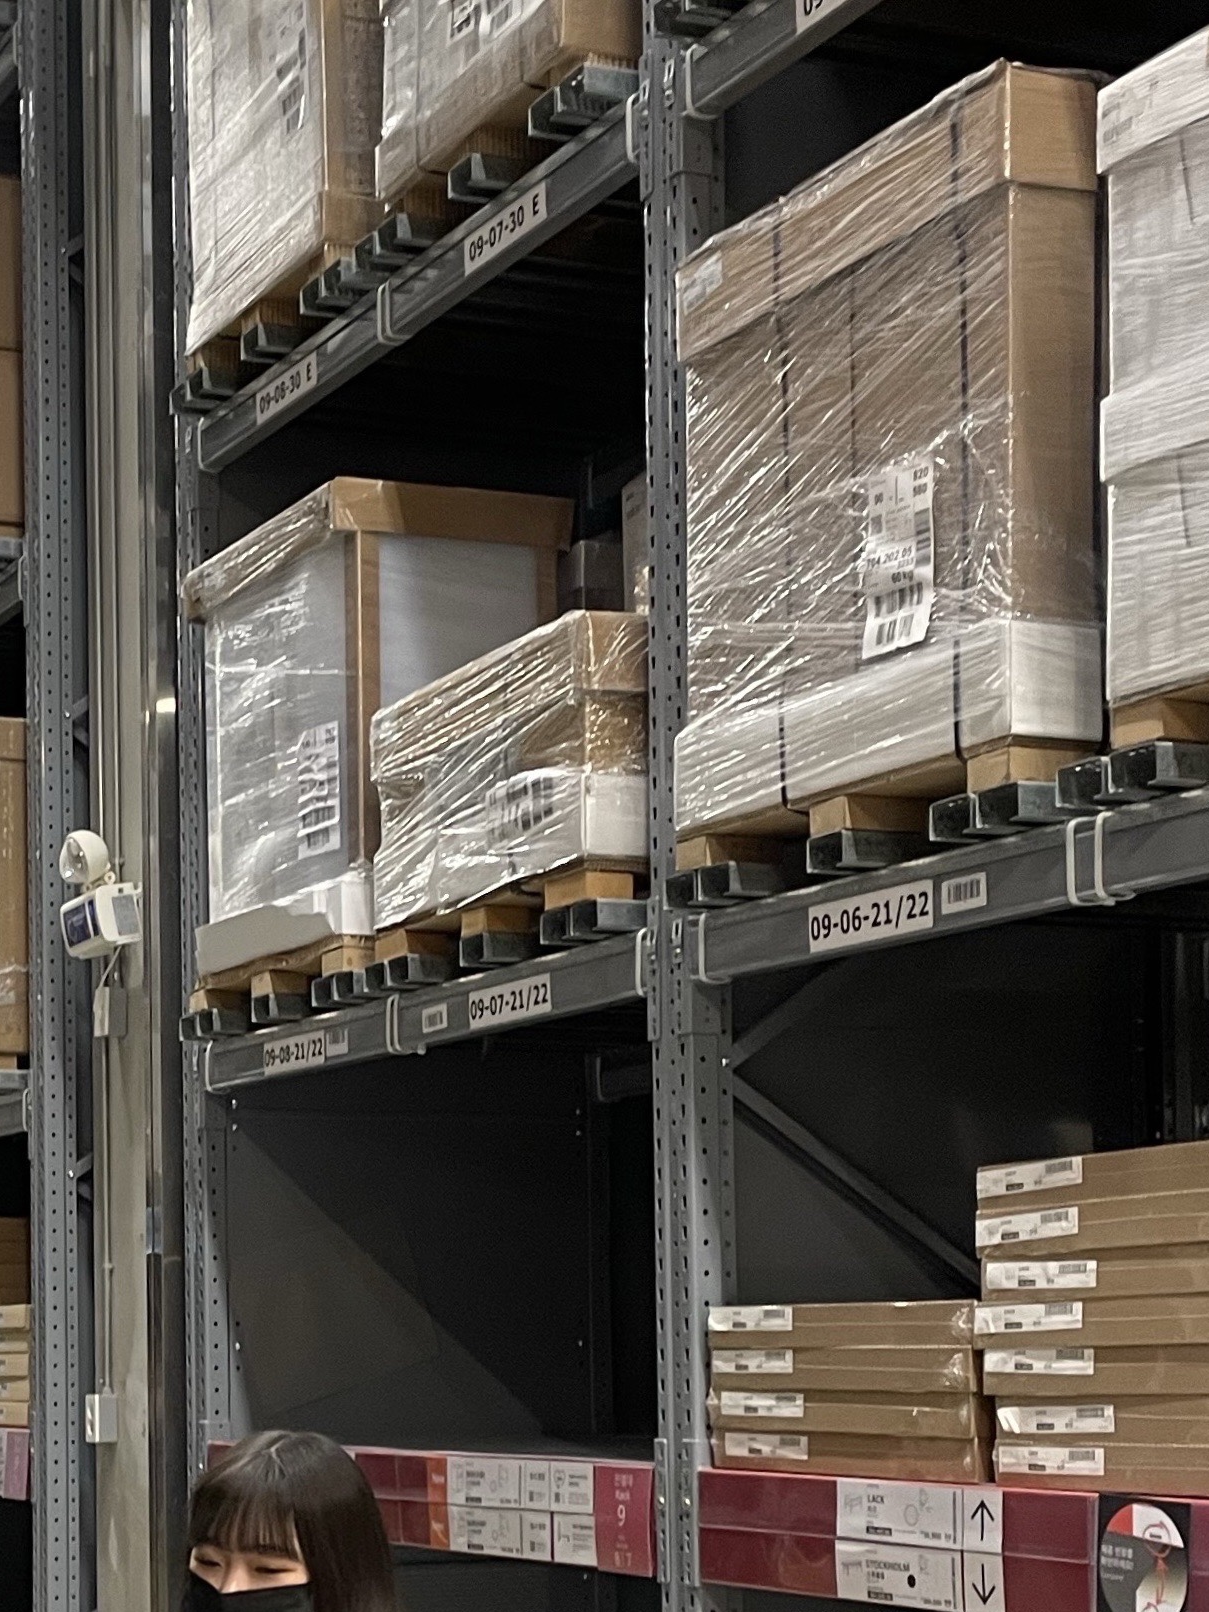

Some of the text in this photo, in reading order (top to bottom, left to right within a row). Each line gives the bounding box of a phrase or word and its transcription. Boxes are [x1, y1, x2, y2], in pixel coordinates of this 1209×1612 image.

[468, 192, 540, 262] 09-07-30 E
[810, 891, 930, 941] 09-06-21/22
[470, 982, 549, 1021] 09-07-21/22
[616, 1504, 626, 1527] 9
[867, 1494, 885, 1504] LACK
